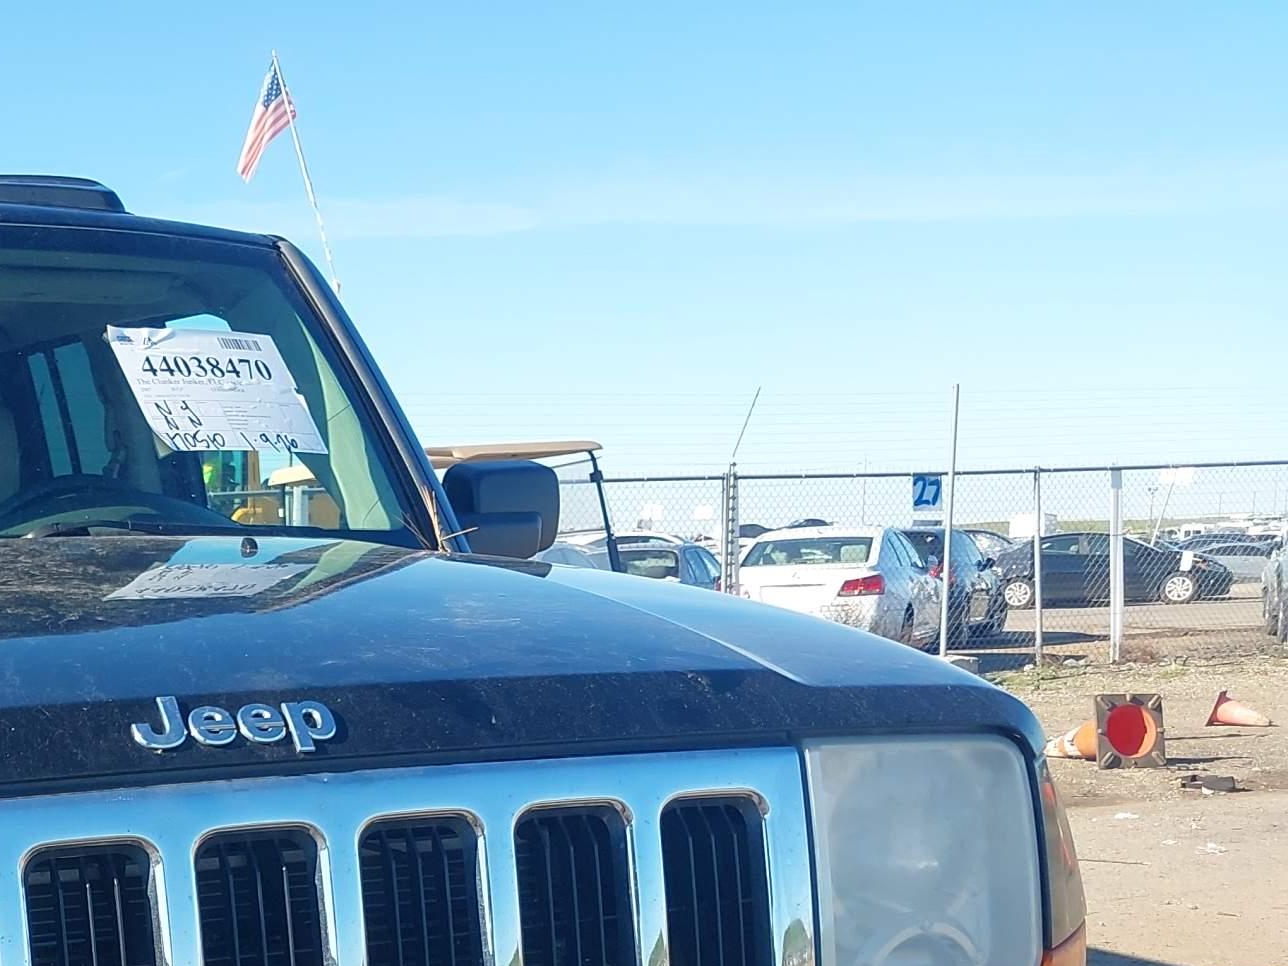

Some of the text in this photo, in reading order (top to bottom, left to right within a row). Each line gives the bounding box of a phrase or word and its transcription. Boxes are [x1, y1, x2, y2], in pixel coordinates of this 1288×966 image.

[141, 355, 273, 381] 44038470
[913, 476, 940, 506] 27
[130, 695, 337, 752] Jeep
